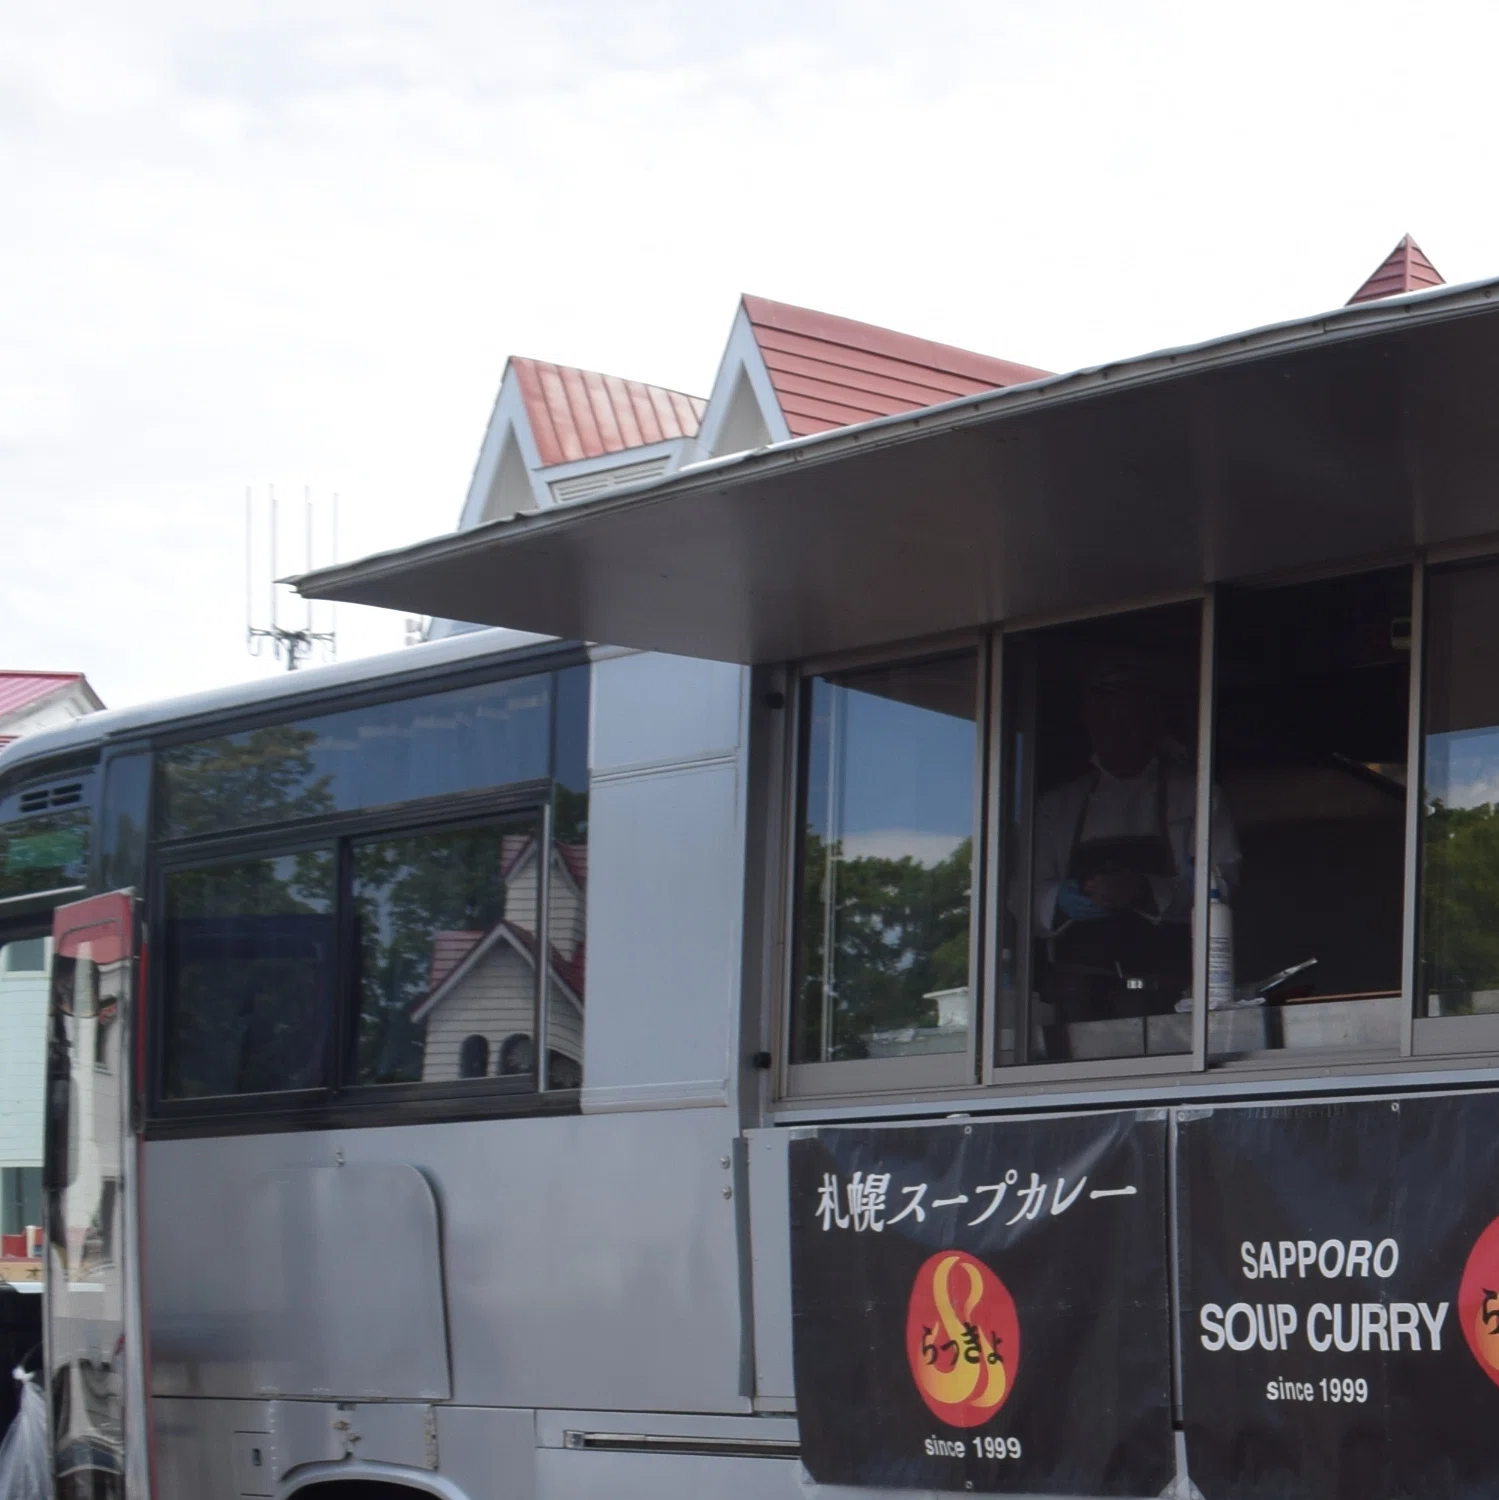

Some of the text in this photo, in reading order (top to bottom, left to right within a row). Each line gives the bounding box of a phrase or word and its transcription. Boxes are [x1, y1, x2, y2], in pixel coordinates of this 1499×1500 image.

[815, 1168, 1137, 1232] 札幌スープカレー
[1241, 1238, 1400, 1279] SAPPORO
[922, 1321, 1005, 1367] らっきょ
[1200, 1301, 1450, 1352] SOUP CURRY
[1266, 1376, 1369, 1403] since 1999
[924, 1434, 1022, 1459] since 1999
